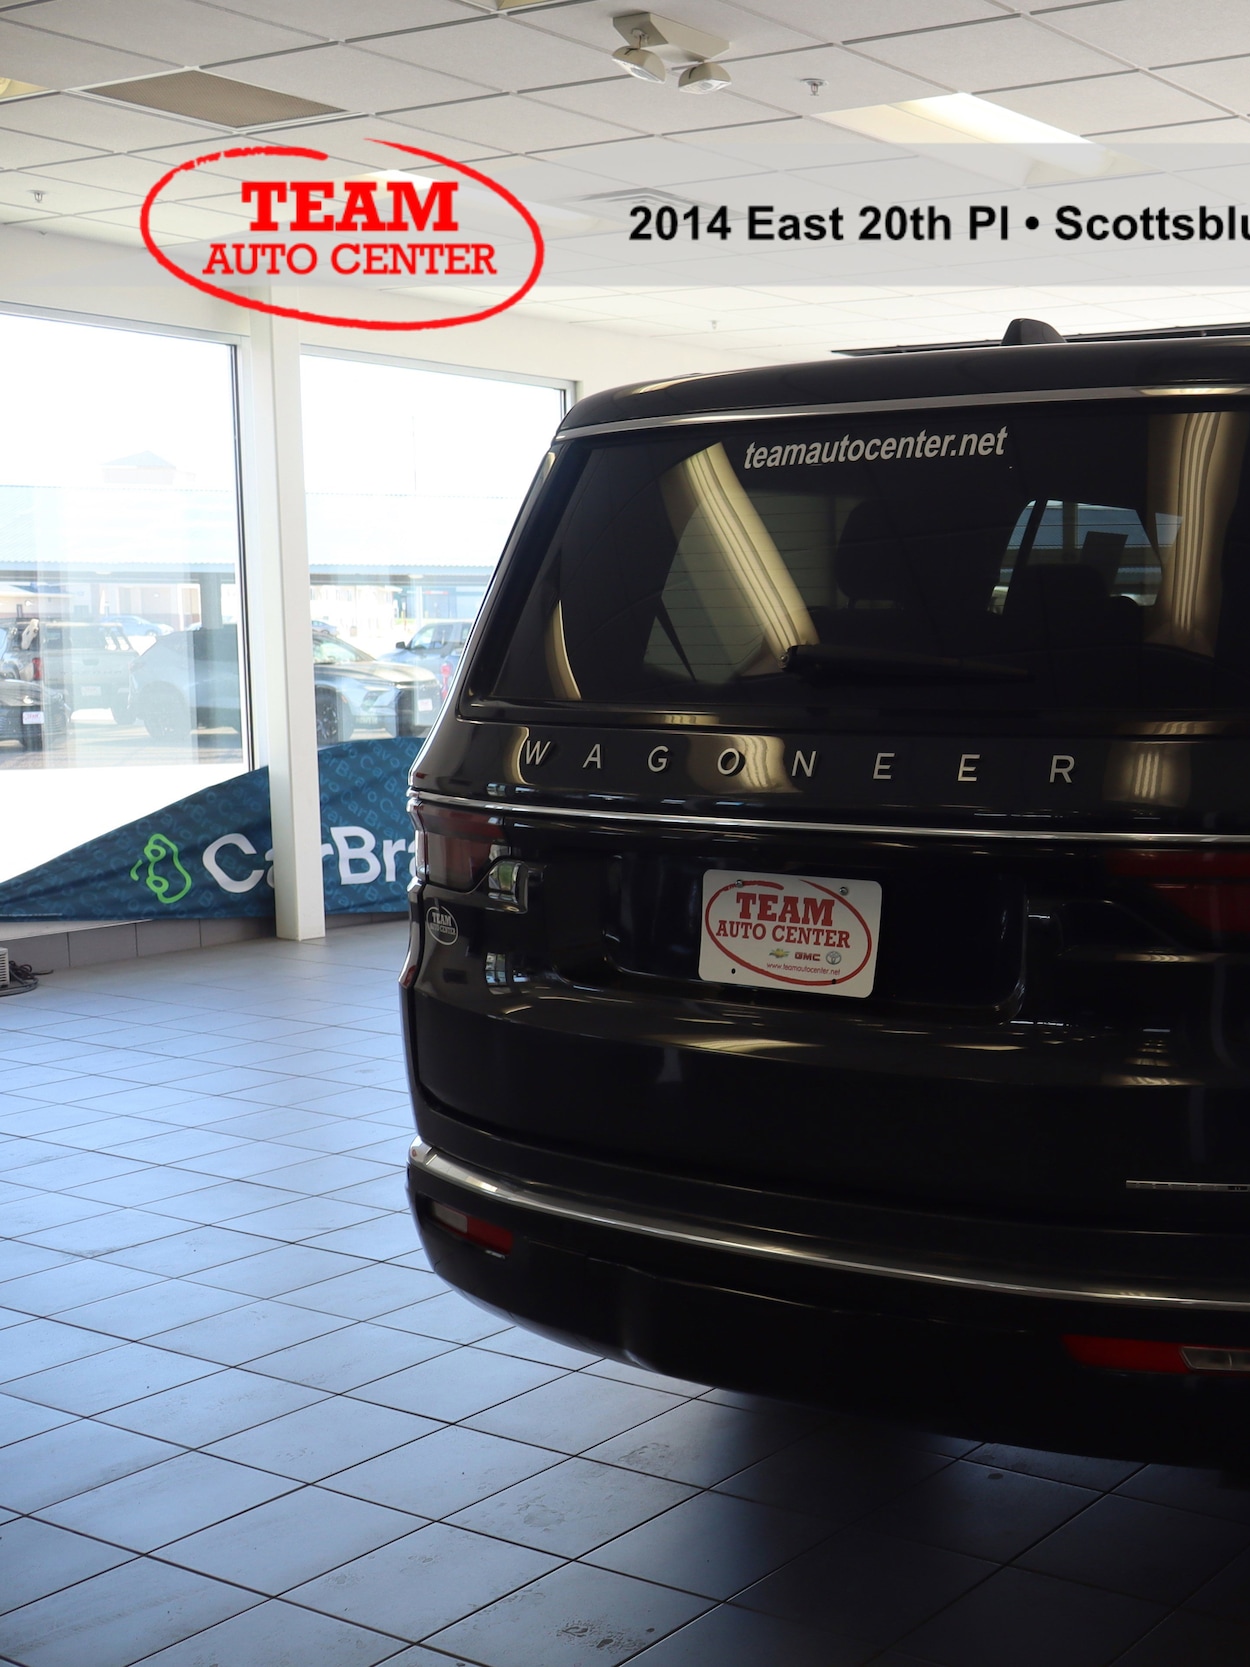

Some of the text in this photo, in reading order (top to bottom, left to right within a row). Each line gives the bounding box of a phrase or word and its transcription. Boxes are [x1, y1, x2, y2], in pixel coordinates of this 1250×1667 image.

[743, 426, 1008, 470] teamautocenter.net
[524, 740, 1076, 783] WAGONEER
[431, 911, 452, 927] TEAM
[736, 892, 835, 926] TEAM
[716, 920, 851, 948] AUTO CENTER
[766, 962, 841, 976] www.teamautocenter.net
[794, 951, 821, 961] GMC
